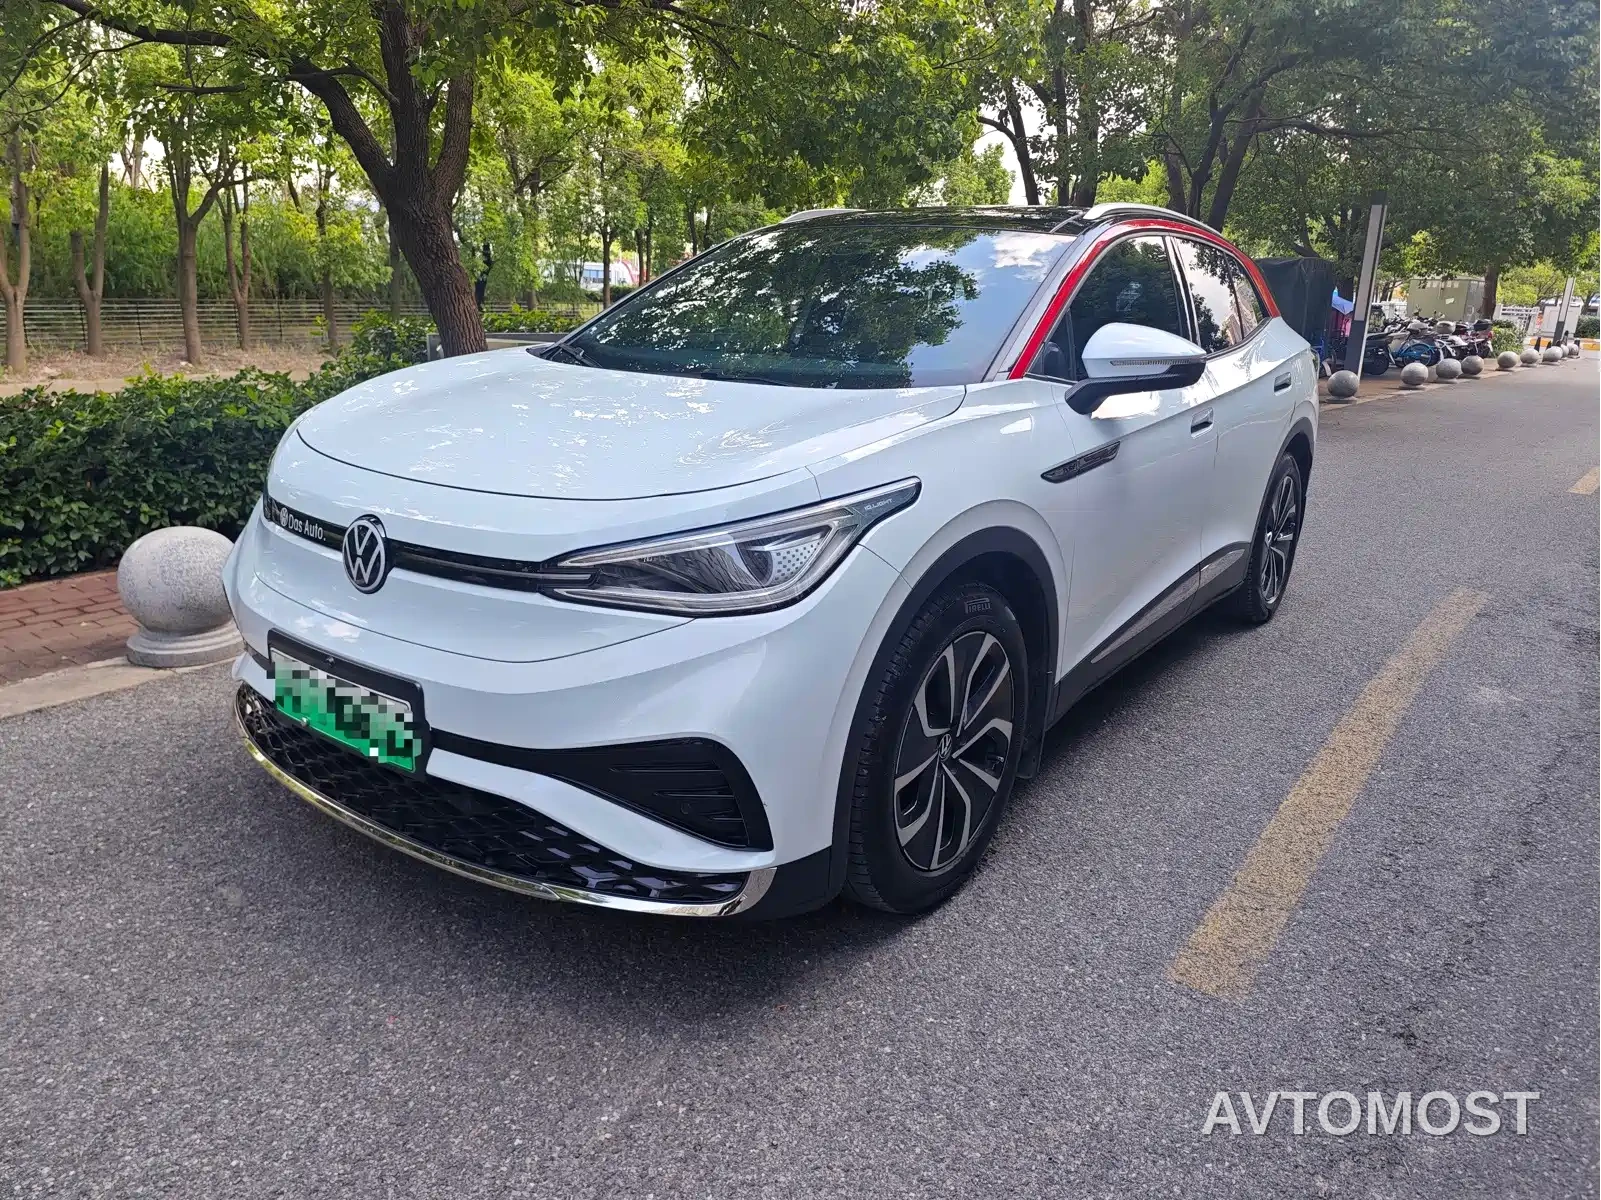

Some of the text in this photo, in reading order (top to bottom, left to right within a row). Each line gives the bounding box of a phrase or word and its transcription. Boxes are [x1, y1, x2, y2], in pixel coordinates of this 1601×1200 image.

[288, 513, 303, 533] Das
[303, 519, 327, 542] Auto.
[964, 597, 991, 614] PIRELLI
